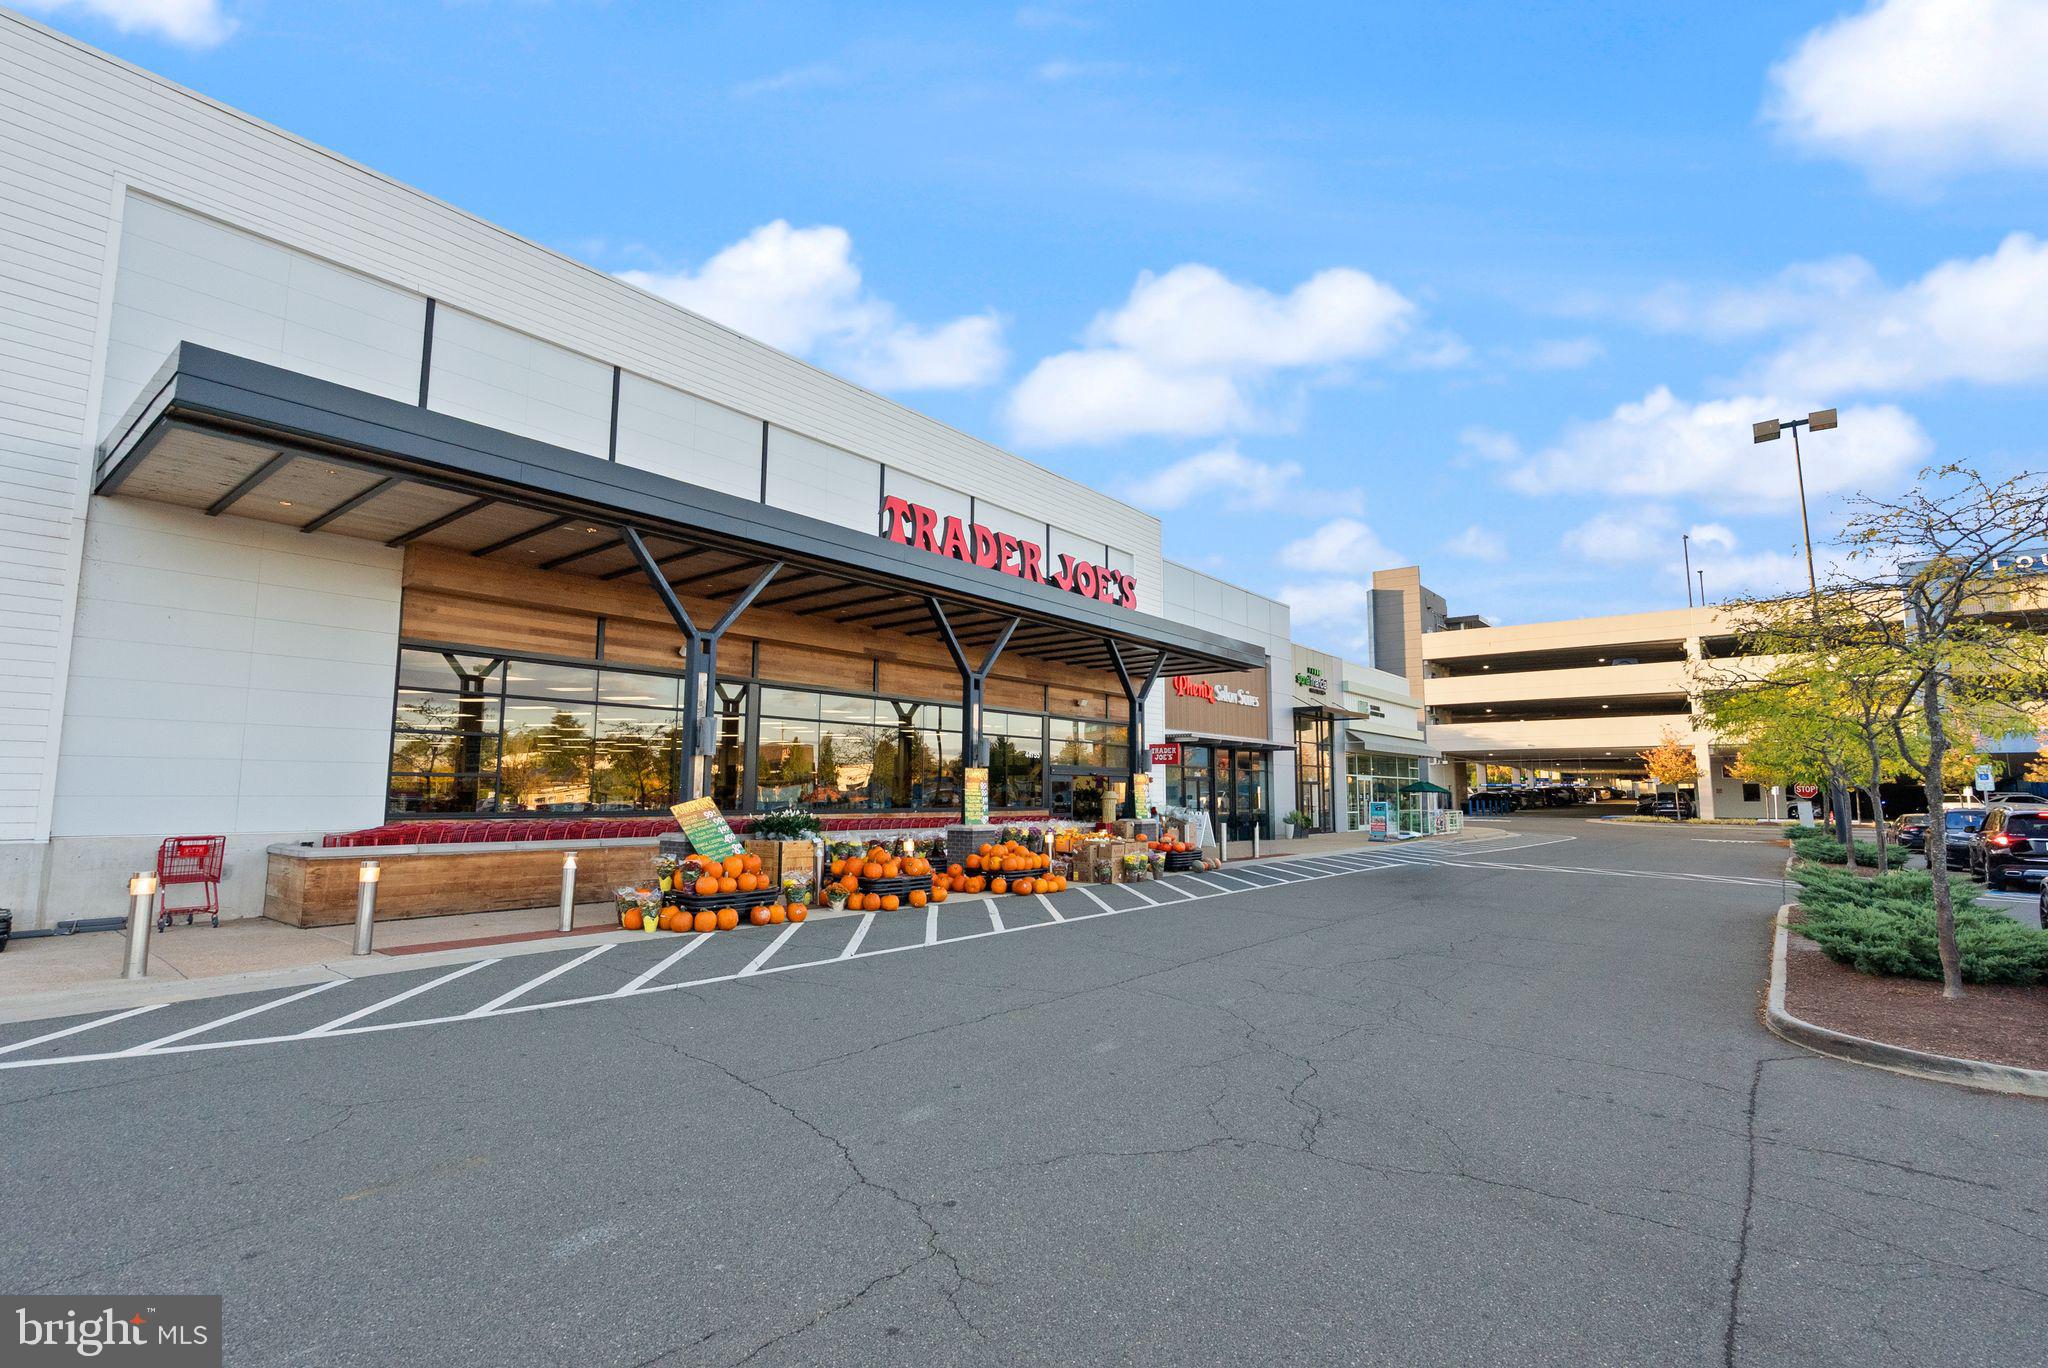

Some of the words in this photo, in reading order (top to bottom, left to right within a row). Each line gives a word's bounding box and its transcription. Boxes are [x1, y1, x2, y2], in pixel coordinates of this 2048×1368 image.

[879, 495, 1046, 585] TRADER
[1050, 553, 1138, 611] JOE'S
[1173, 675, 1216, 704] Phenix
[1151, 747, 1177, 755] TRADER
[1796, 785, 1816, 793] STOP
